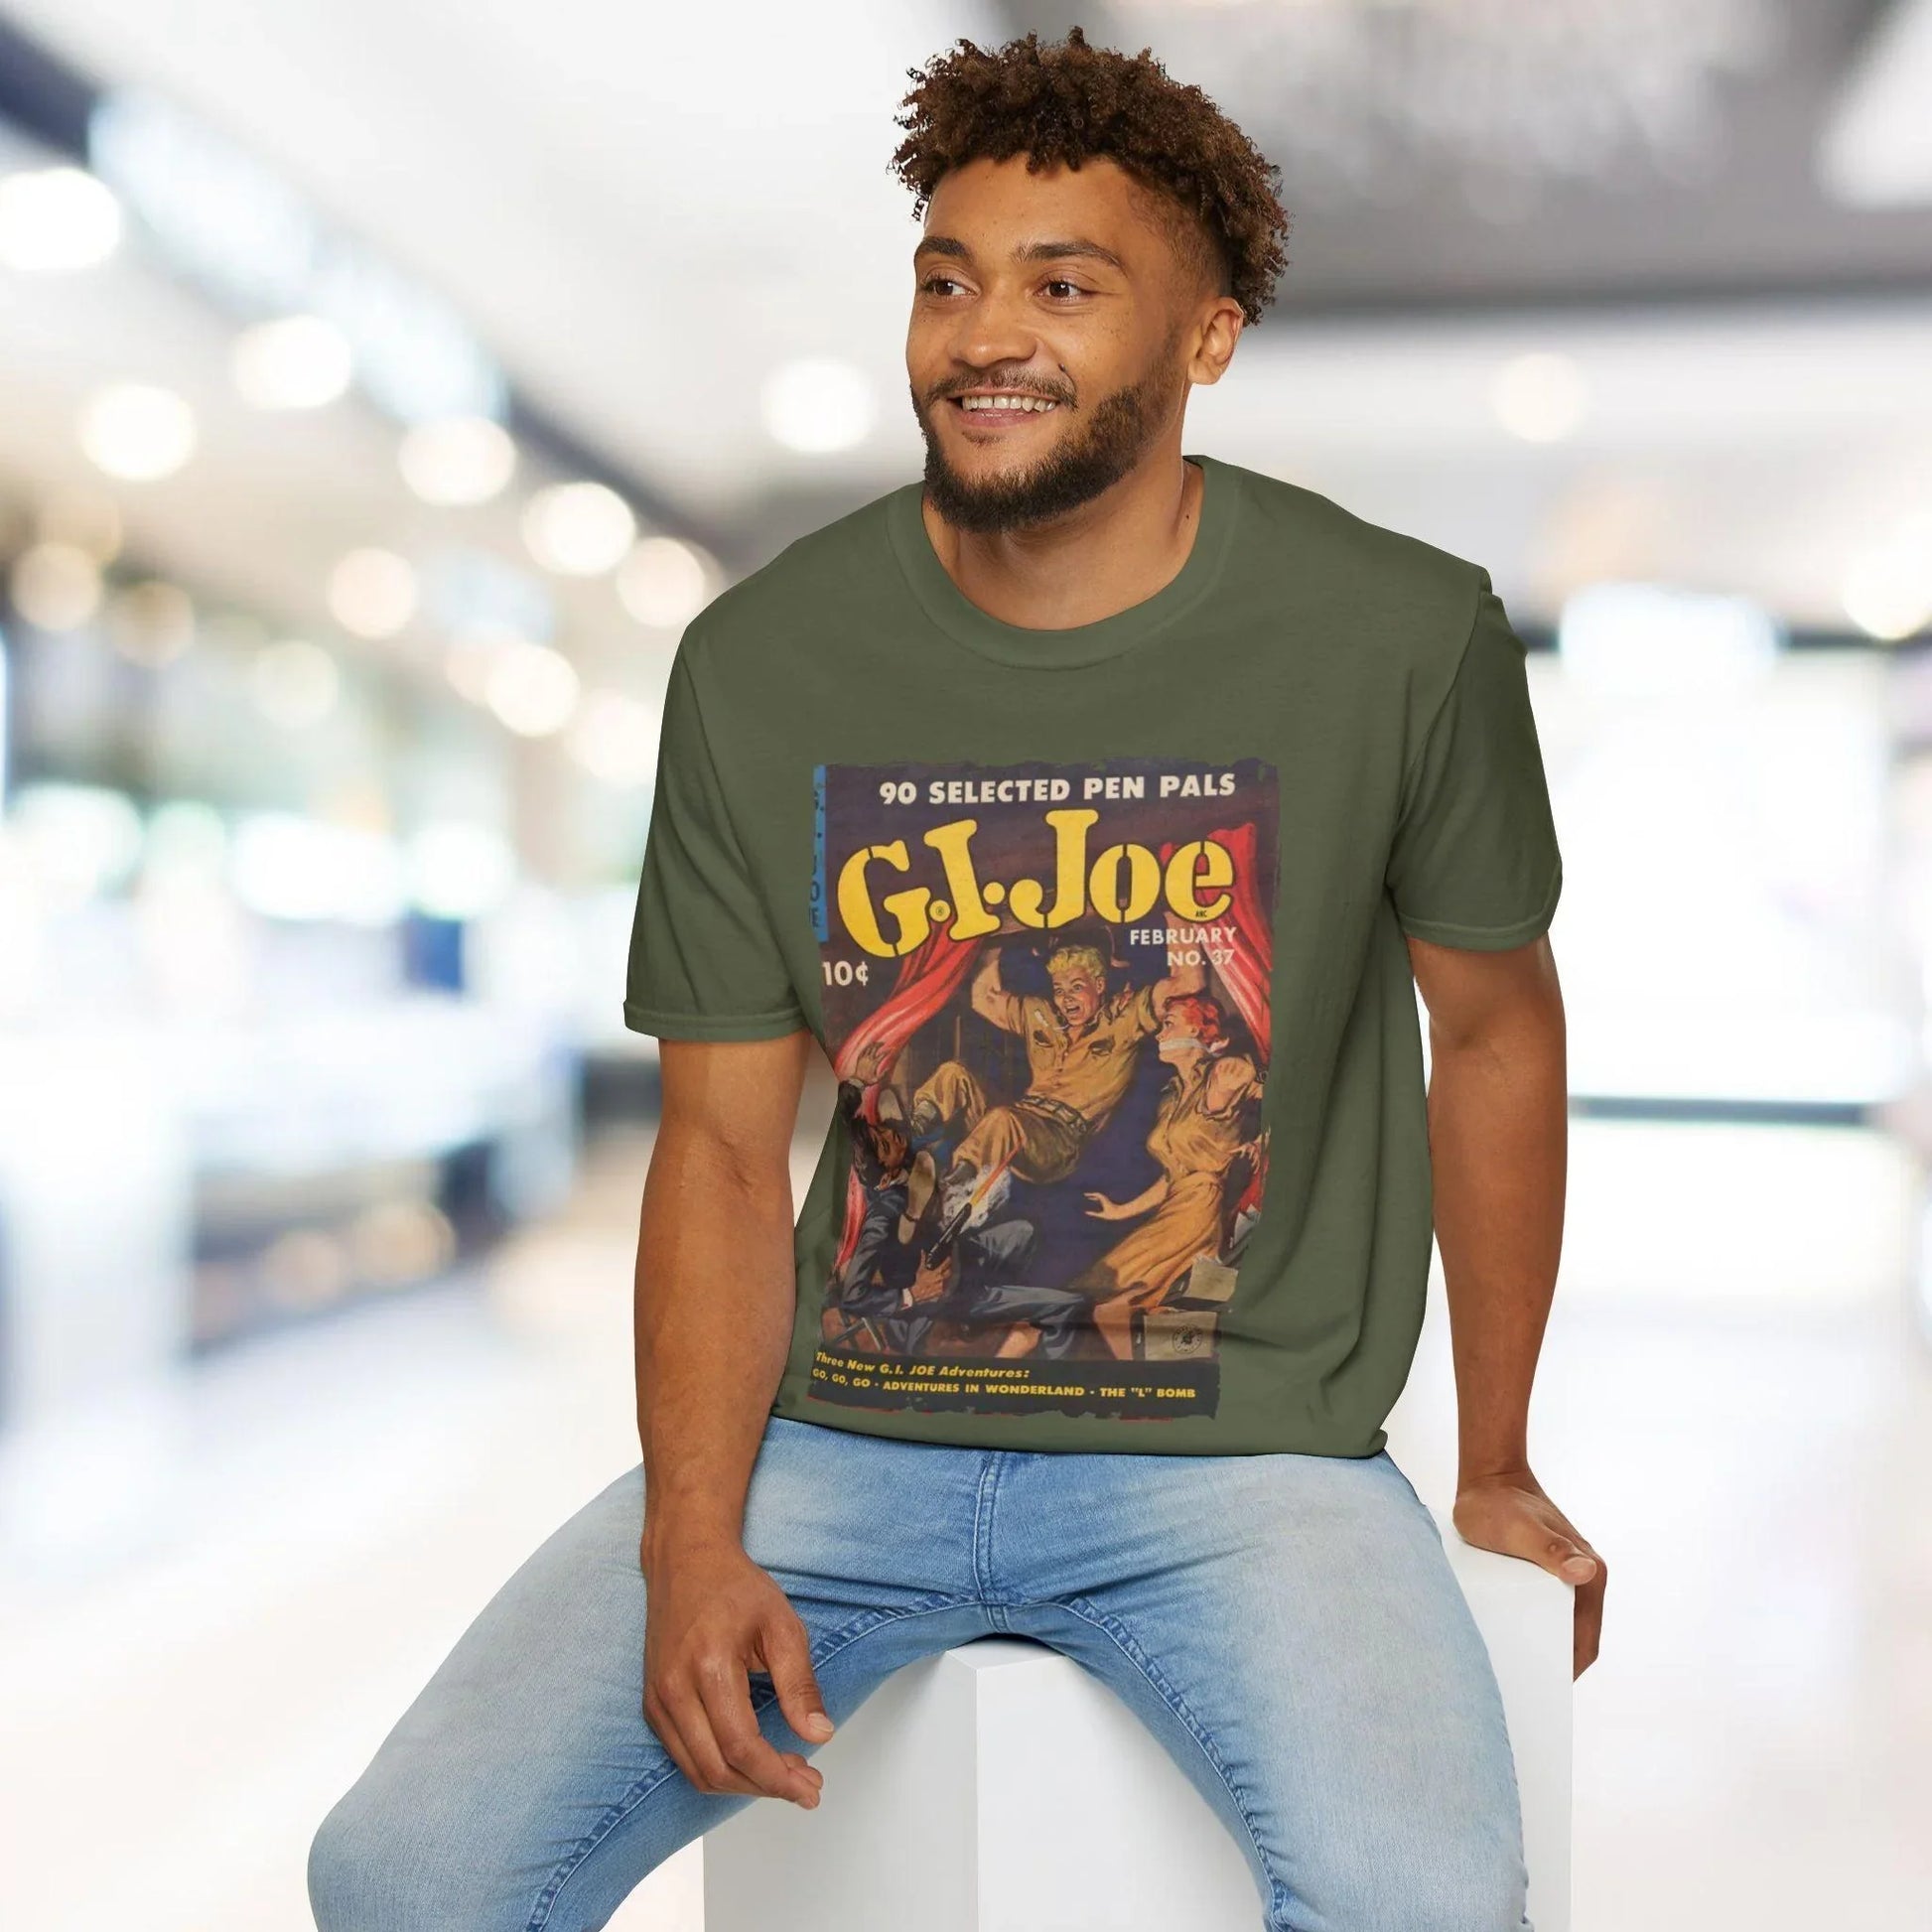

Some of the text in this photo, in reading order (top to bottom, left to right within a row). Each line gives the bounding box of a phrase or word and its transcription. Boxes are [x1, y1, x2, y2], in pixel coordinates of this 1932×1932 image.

[879, 773, 1237, 805] 90 SELECTED PEN PALS
[1130, 925, 1238, 946] FEBRUARY
[1167, 947, 1236, 967] NO. 37
[816, 1351, 844, 1367] Three
[847, 1359, 876, 1372] New
[908, 1364, 936, 1376] JOE
[938, 1365, 1030, 1378] Adventures:
[811, 1367, 829, 1381] GO,
[831, 1372, 849, 1387] GO,
[852, 1376, 872, 1389] GO
[883, 1381, 960, 1393] ADVENTURES
[964, 1382, 980, 1394] IN
[985, 1384, 1085, 1396] WONDERLAND
[1099, 1386, 1127, 1398] THE
[1156, 1387, 1196, 1399] BOMB
